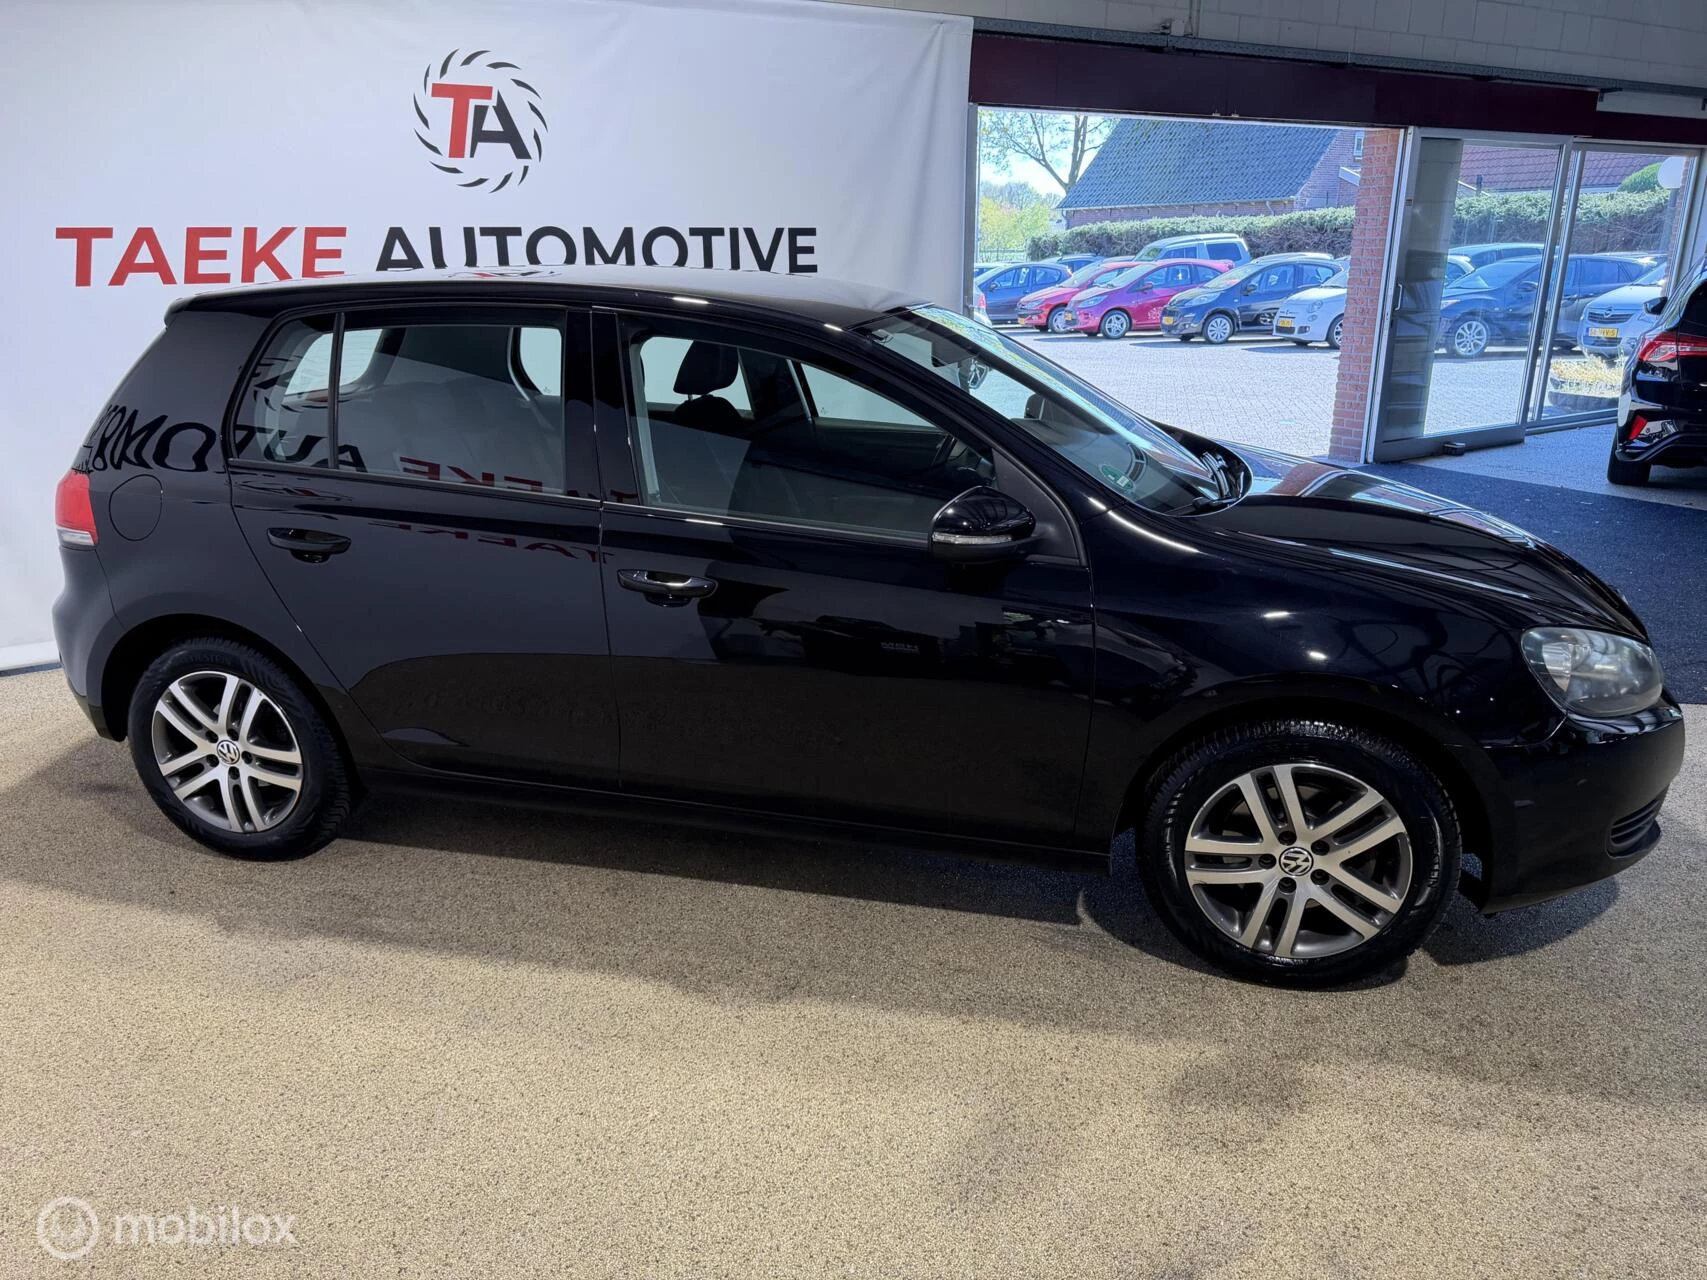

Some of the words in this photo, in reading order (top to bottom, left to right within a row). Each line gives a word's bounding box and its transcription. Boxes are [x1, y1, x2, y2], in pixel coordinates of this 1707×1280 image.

[431, 83, 532, 160] TA
[56, 226, 347, 287] TAEKE
[376, 226, 819, 273] AUTOMOTIVE
